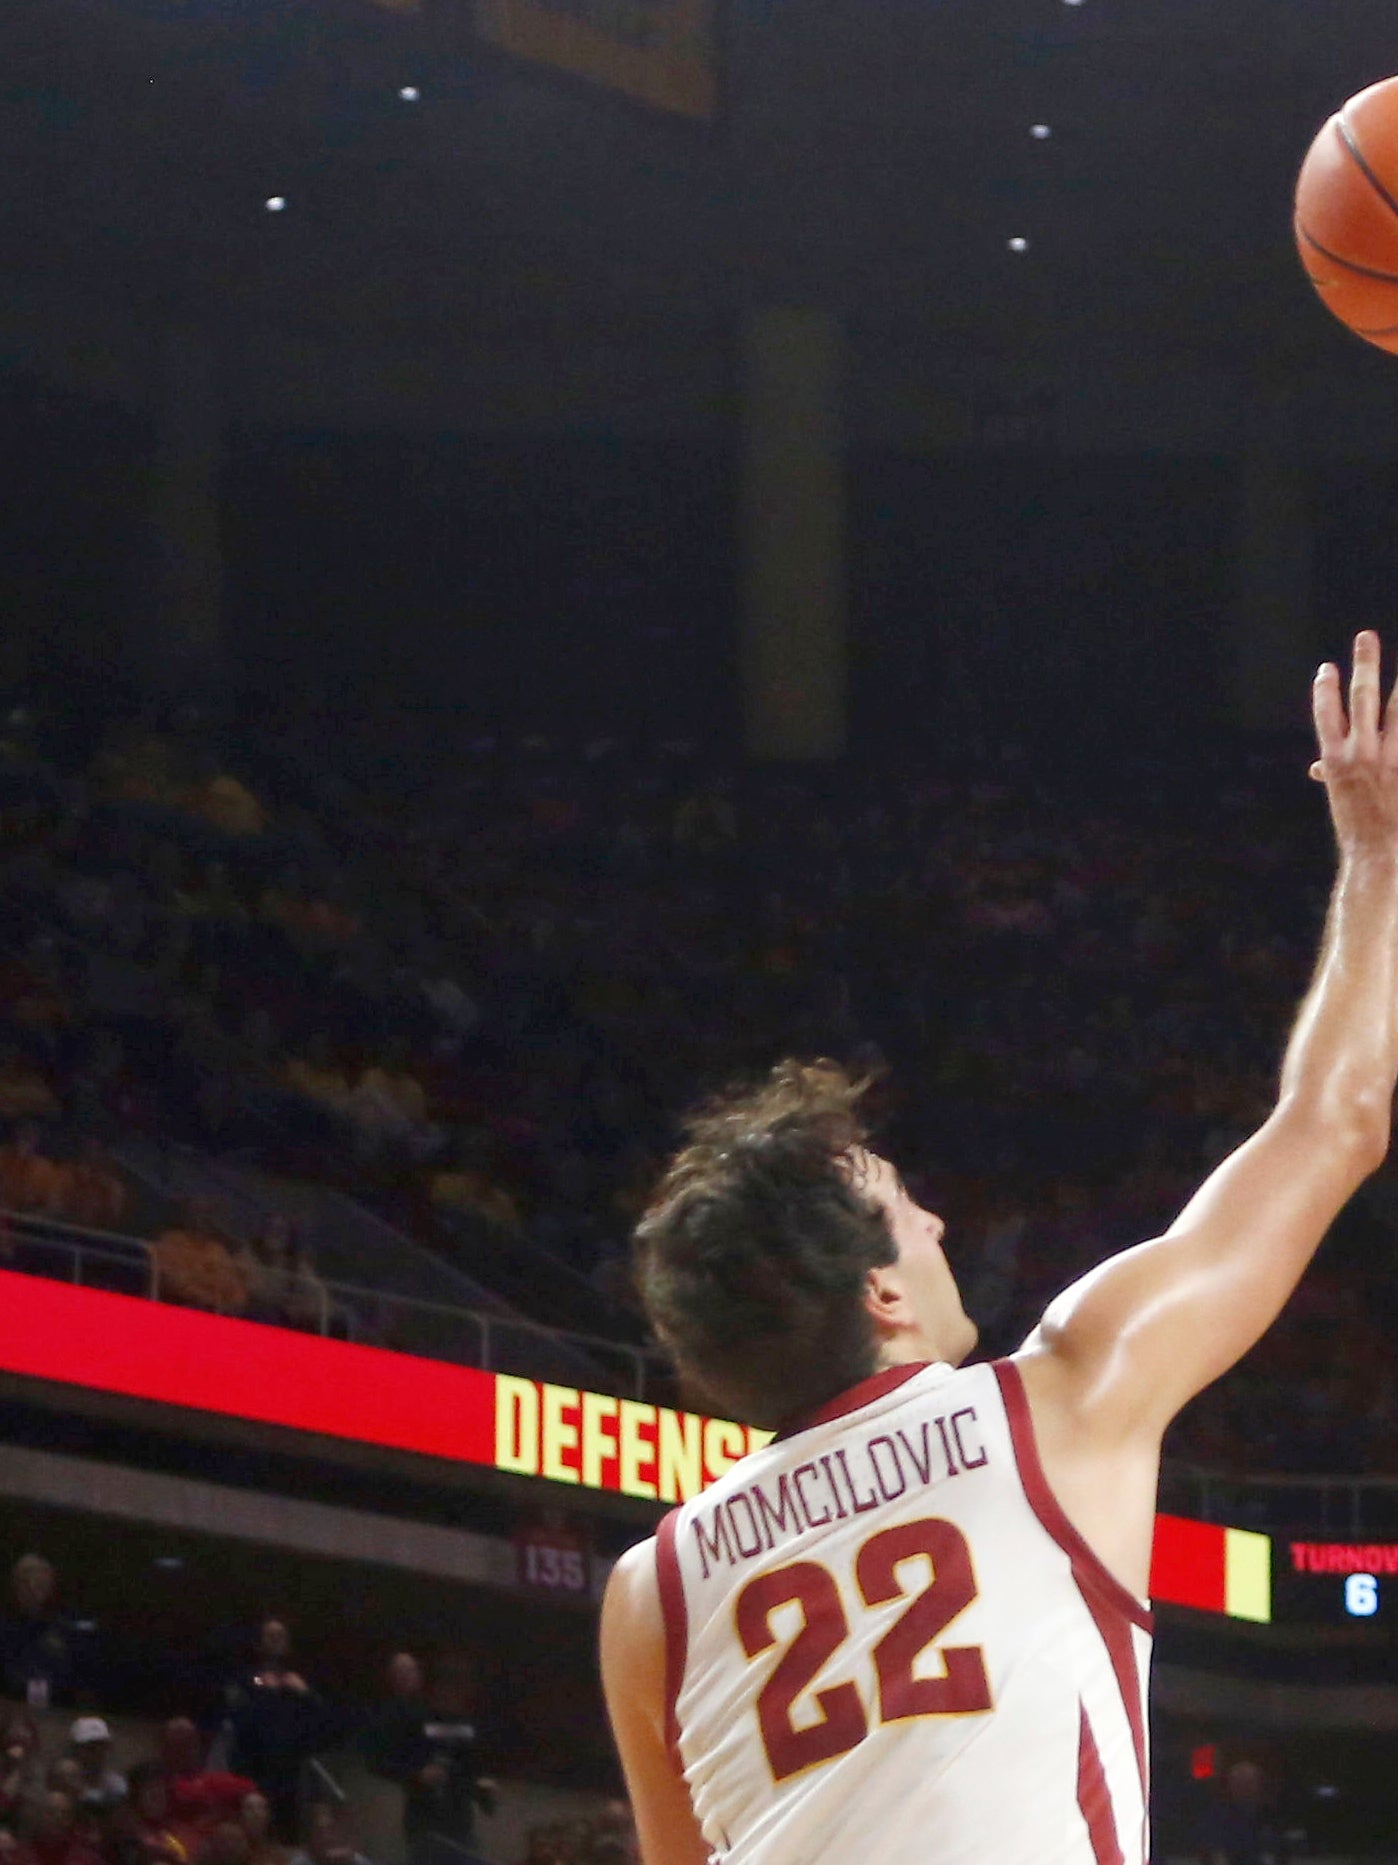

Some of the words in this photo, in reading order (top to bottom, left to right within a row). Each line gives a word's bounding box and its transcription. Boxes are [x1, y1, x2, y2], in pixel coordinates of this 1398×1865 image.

[690, 1406, 989, 1578] MOMCILOVIC
[732, 1516, 996, 1784] 22
[1344, 1572, 1379, 1617] 6
